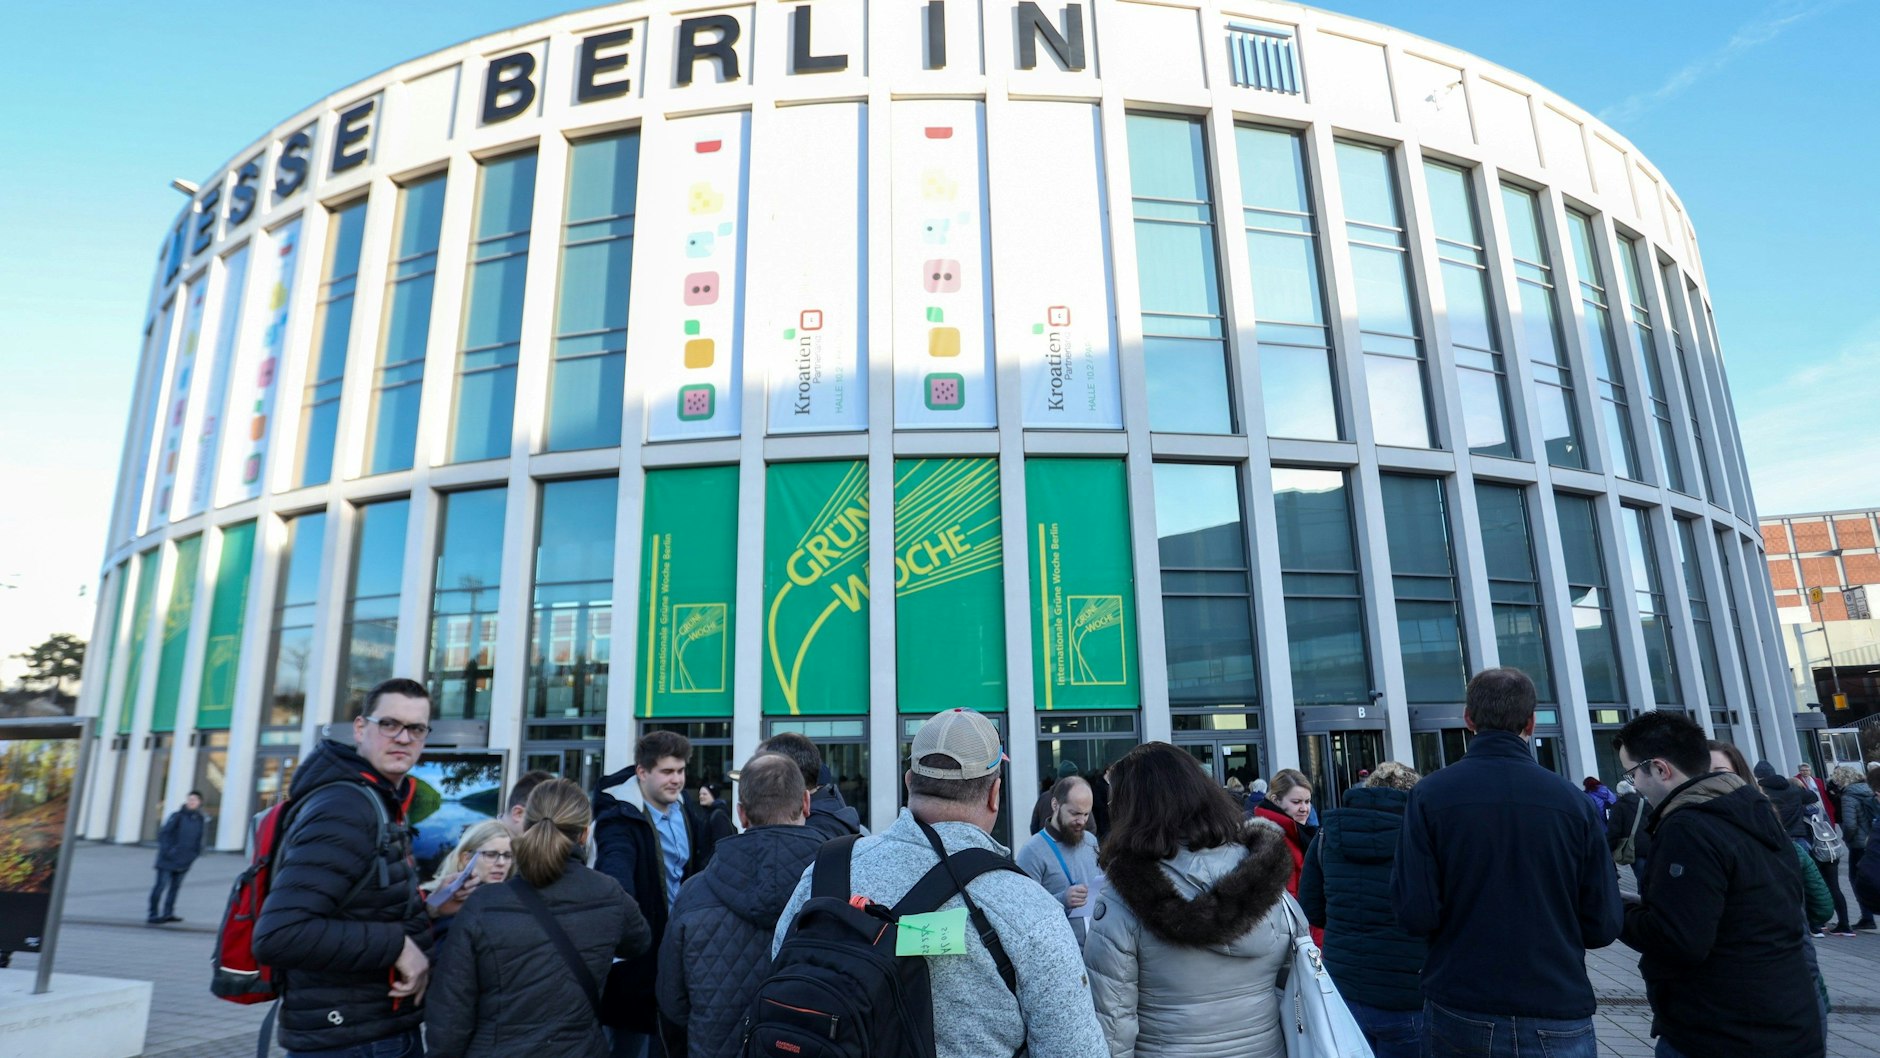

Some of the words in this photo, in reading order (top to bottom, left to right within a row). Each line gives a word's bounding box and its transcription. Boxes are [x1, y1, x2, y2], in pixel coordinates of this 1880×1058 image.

[482, 0, 1086, 124] BERLIN
[794, 336, 811, 416] Kroatien
[1045, 332, 1065, 411] Kroatien
[1086, 364, 1095, 380] 10.2
[834, 385, 844, 414] HALLE
[1087, 383, 1097, 411] HALLE
[662, 533, 672, 560] Berlin
[786, 488, 868, 587] GRÜN
[1050, 523, 1060, 550] Berlin
[661, 562, 670, 593] Woche
[1051, 552, 1062, 584] Woche
[660, 596, 669, 625] Grüne
[1053, 586, 1063, 616] Grüne
[1085, 613, 1113, 632] WOCHE
[657, 626, 668, 694] Internationale
[1054, 618, 1065, 686] Internationale
[1358, 706, 1366, 718] B
